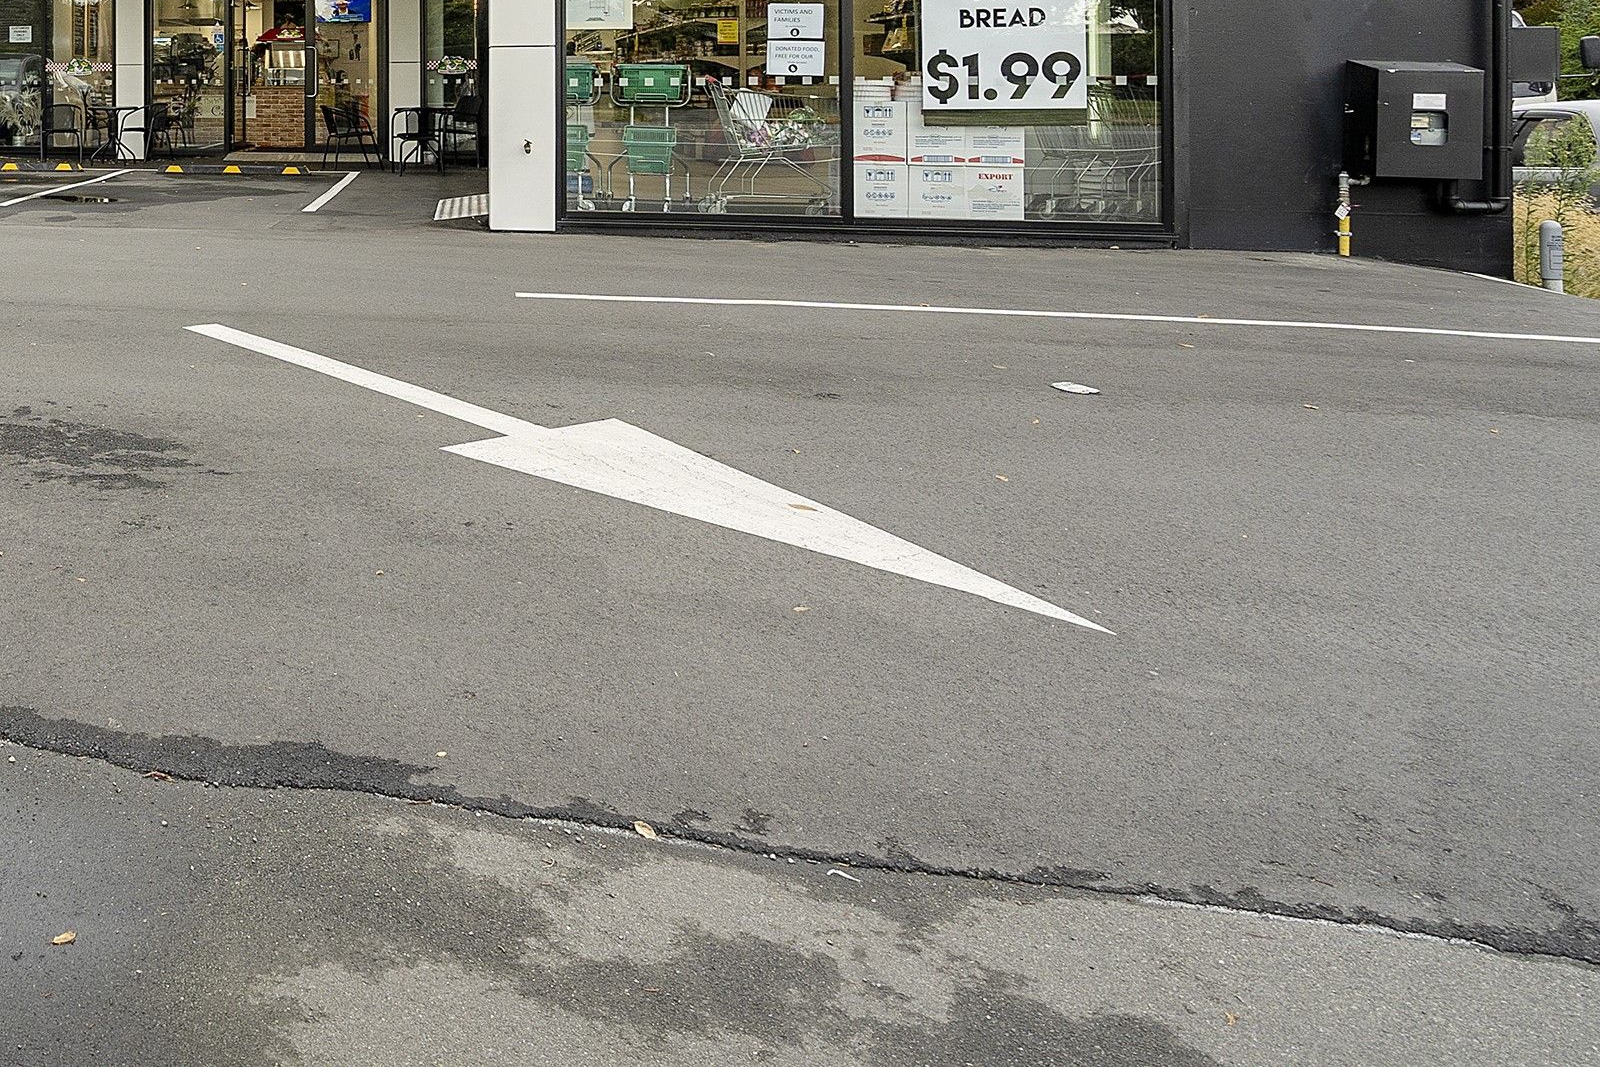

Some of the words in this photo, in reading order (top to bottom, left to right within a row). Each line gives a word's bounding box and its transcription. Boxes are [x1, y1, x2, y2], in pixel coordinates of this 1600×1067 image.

[959, 7, 1046, 28] BREAD
[927, 49, 1082, 105] $1.99
[978, 173, 1014, 181] EXPORT
